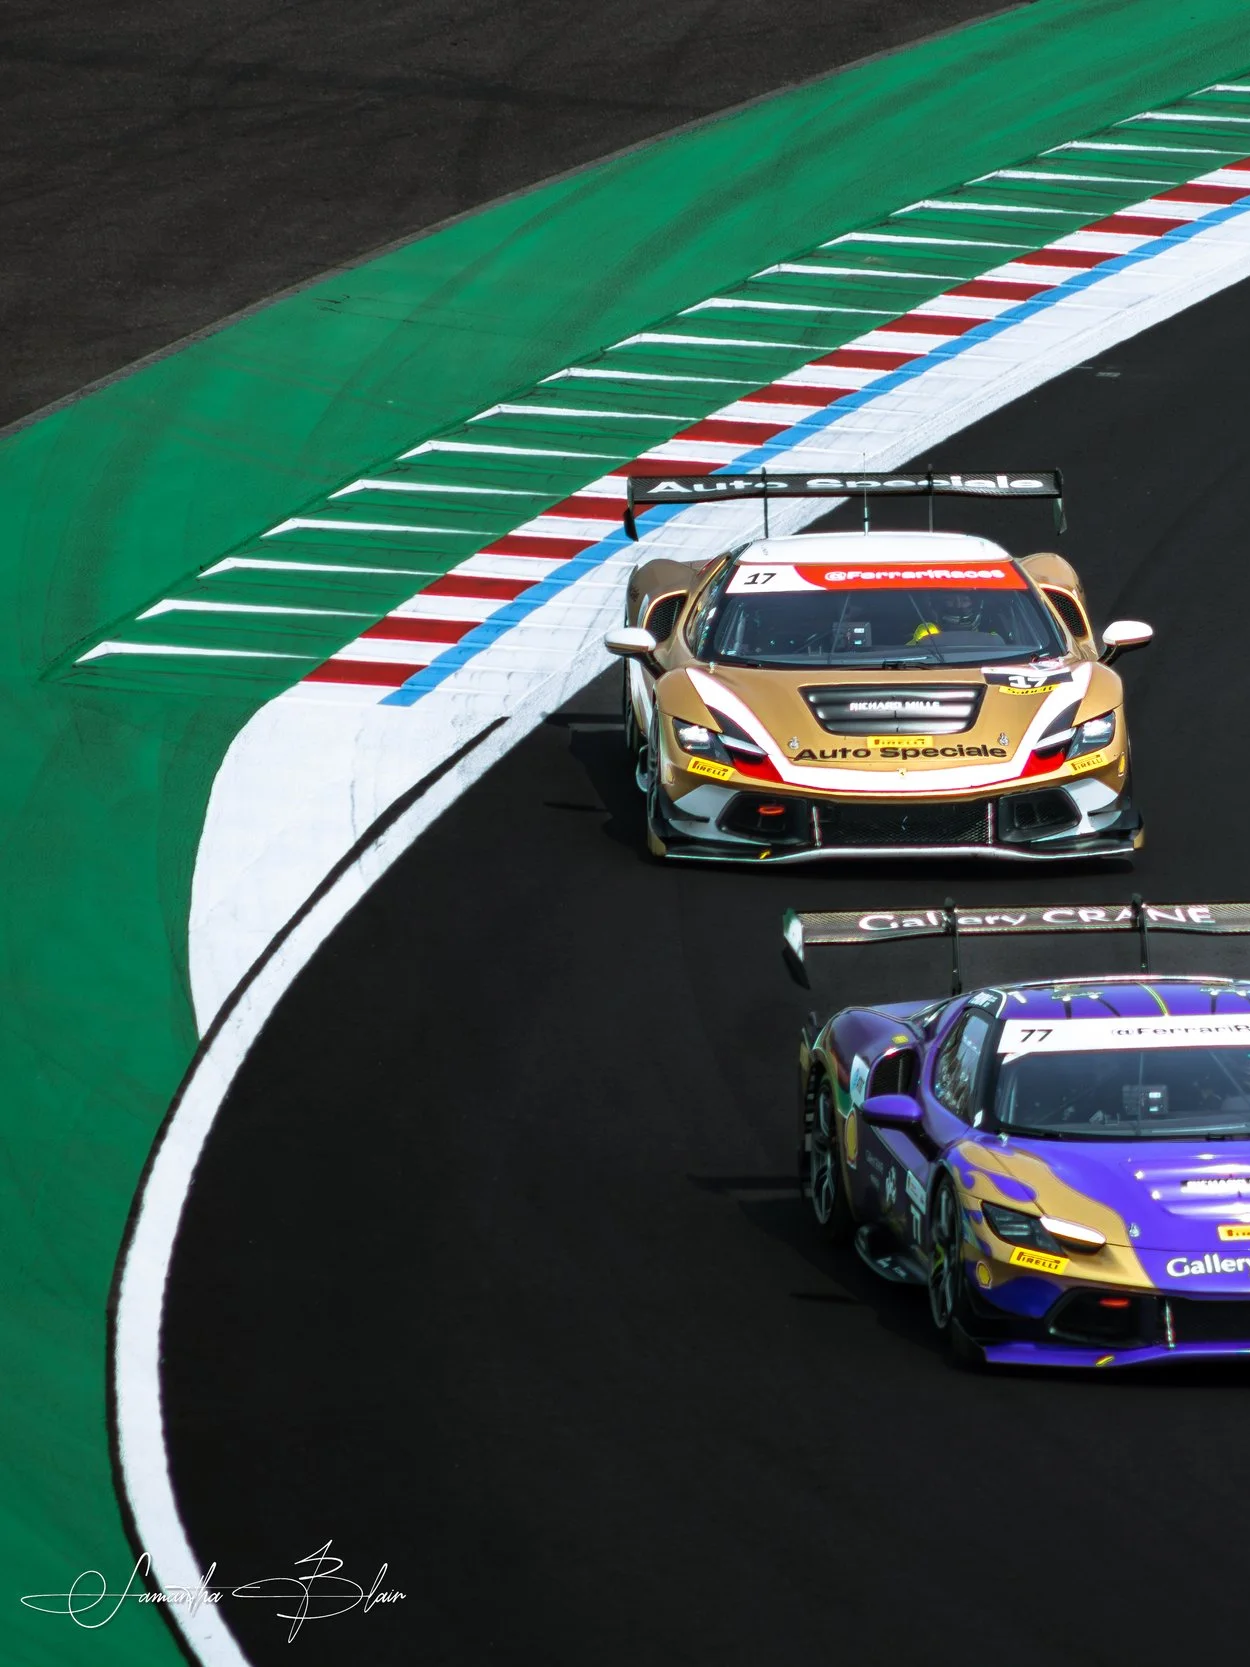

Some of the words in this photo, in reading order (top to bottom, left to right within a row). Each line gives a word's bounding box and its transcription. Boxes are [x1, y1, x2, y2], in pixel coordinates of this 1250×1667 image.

[647, 480, 788, 494] Auto
[806, 475, 1044, 489] Speciale
[743, 573, 777, 585] 17
[824, 569, 1005, 582] @FerrariRaces
[1008, 676, 1048, 689] 17
[849, 701, 901, 712] RICHARD
[793, 747, 871, 761] Auto
[879, 744, 1008, 760] Speciale
[692, 760, 729, 777] PIRELLI
[1070, 754, 1104, 771] PIRELLI
[1020, 1028, 1054, 1043] 77
[1016, 1251, 1061, 1270] PIRELLI
